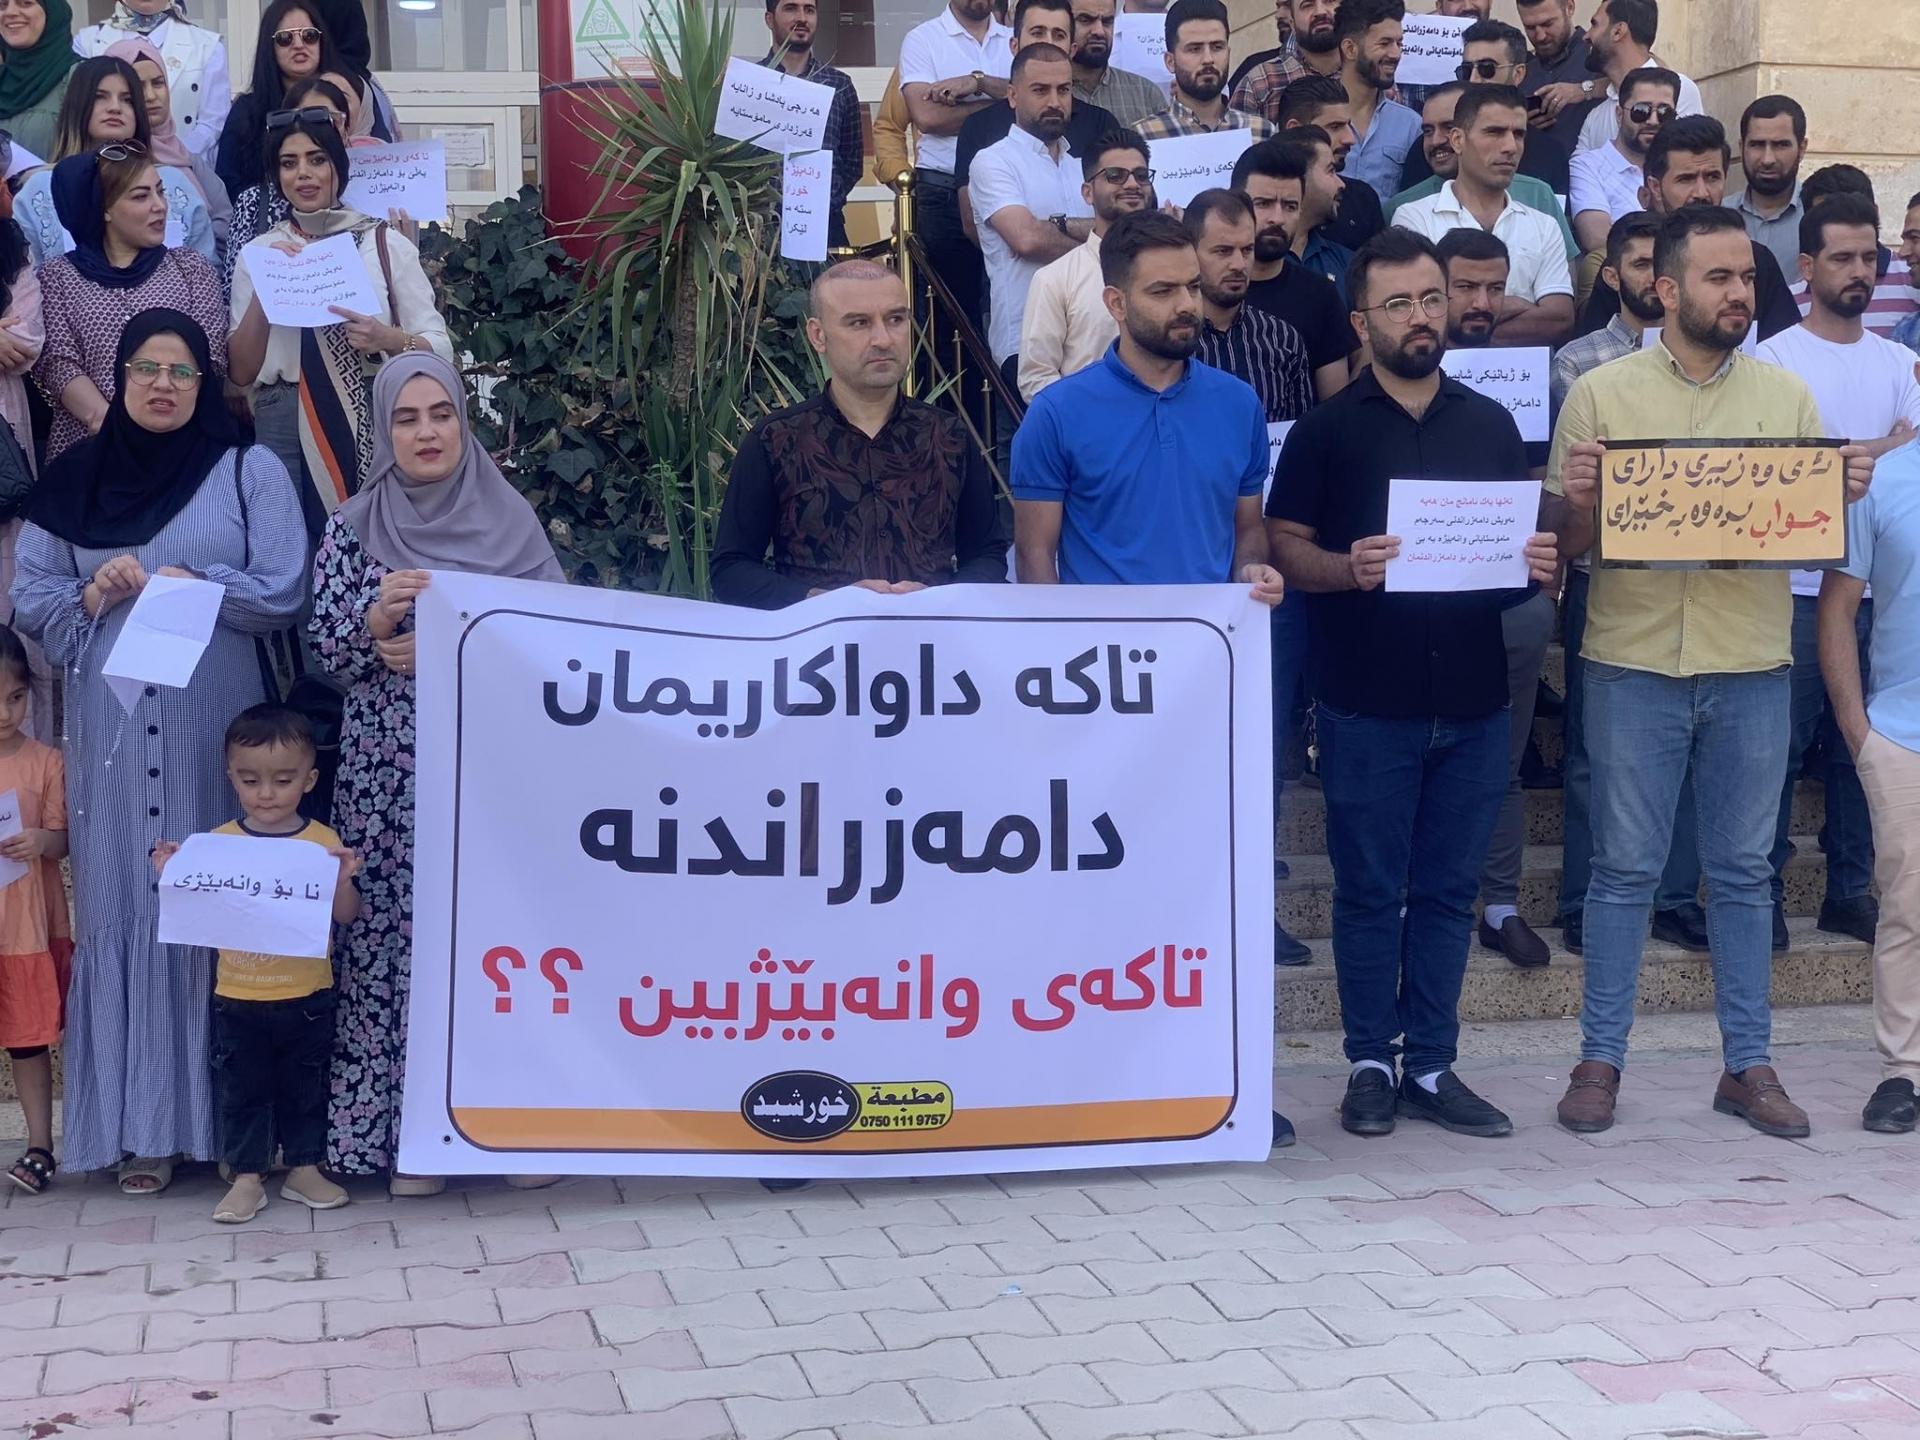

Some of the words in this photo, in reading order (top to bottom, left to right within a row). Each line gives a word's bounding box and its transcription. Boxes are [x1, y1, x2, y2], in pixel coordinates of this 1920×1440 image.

[543, 643, 982, 738] داواکاریمان
[1015, 644, 1156, 715] تاکە
[579, 778, 1125, 906] دامەزراندنە
[173, 872, 262, 897] وانەبێژی
[271, 878, 293, 900] بۆ
[305, 882, 320, 900] نا
[619, 947, 980, 1041] وانەبێژبین
[1012, 944, 1208, 1032] تاکەی
[860, 1117, 890, 1128] 0750
[894, 1116, 913, 1127] 111
[916, 1114, 946, 1126] 9757
[866, 1086, 945, 1113] مطبعة
